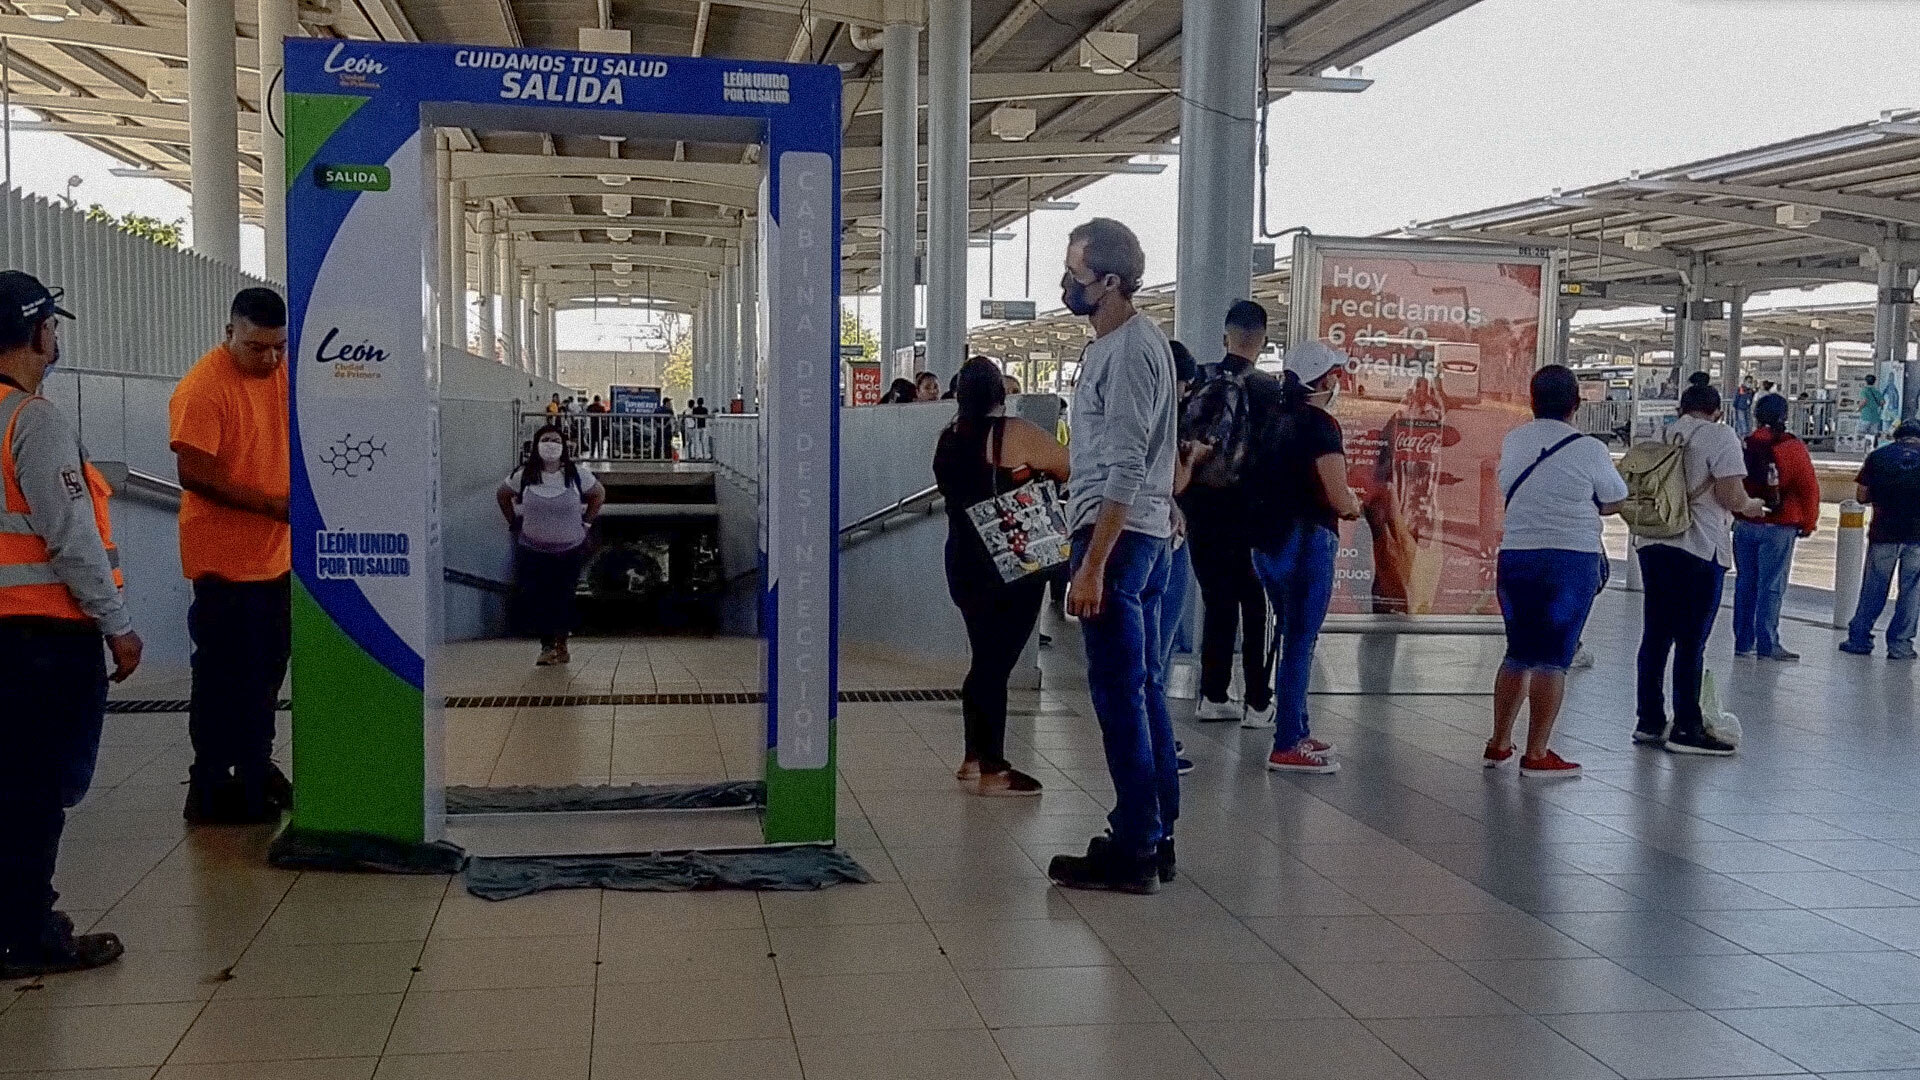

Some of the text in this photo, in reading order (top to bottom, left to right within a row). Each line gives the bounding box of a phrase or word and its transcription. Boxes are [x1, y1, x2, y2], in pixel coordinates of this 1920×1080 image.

[324, 42, 388, 74] León
[455, 50, 668, 78] CUIDAMOS TU SALUD
[500, 71, 623, 105] SALIDA
[723, 68, 790, 91] LEÓN UNIDO
[723, 87, 791, 104] POR TU SALUD
[326, 170, 378, 184] SALIDA
[796, 171, 816, 334] CABINA
[1334, 265, 1388, 295] Hoy
[1330, 295, 1481, 324] reciclamos
[316, 327, 390, 362] León
[1328, 323, 1428, 349] 6 de 10
[855, 372, 876, 383] Hoy
[1345, 353, 1444, 378] otellas.
[796, 359, 815, 407] DE
[856, 382, 880, 391] recic
[865, 390, 878, 400] de
[318, 527, 410, 555] LEÓN UNIDO
[318, 557, 411, 577] POR TU SALUD
